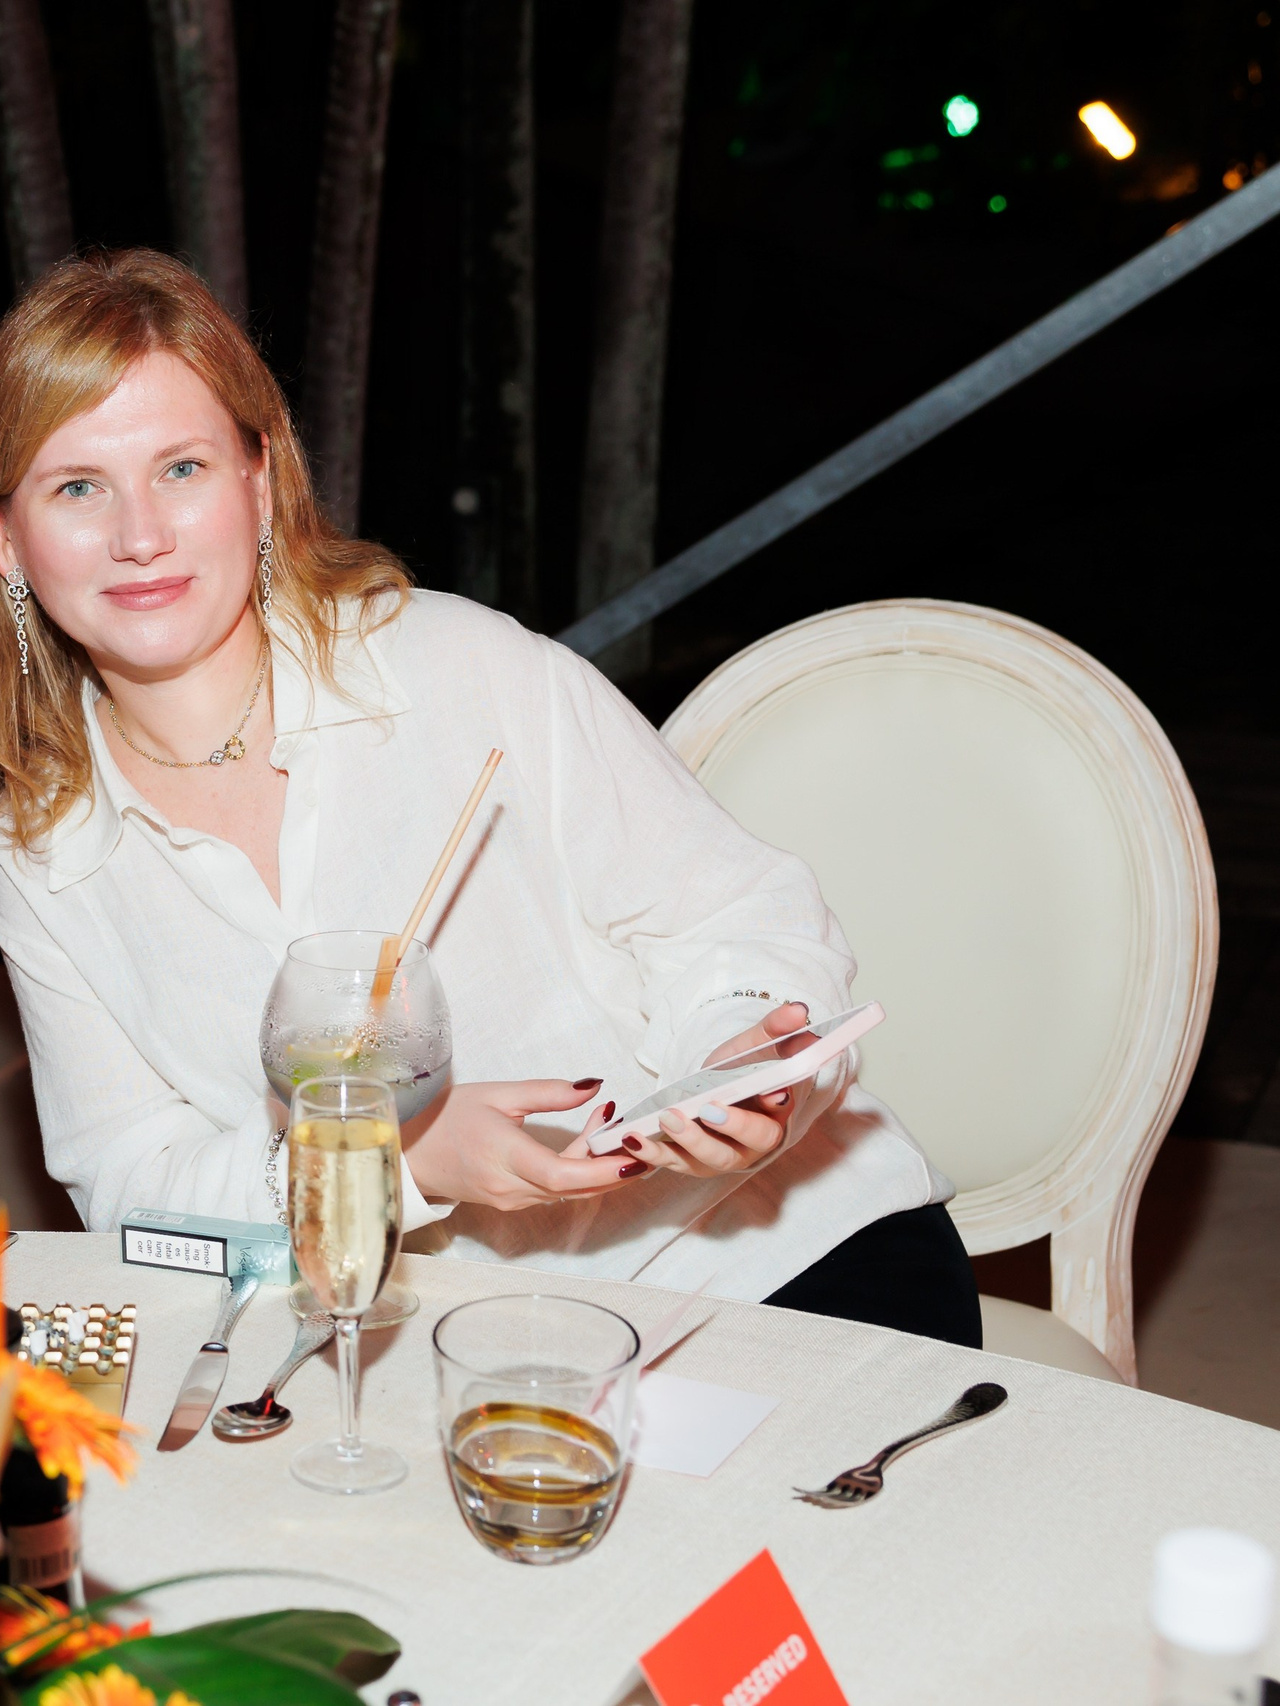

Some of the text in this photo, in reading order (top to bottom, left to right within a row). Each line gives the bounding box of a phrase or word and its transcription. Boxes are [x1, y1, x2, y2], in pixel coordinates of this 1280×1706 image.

[155, 1240, 163, 1258] lung
[165, 1242, 173, 1260] fatal
[175, 1247, 181, 1257] es
[192, 1248, 200, 1261] ing
[203, 1243, 211, 1269] Smok-
